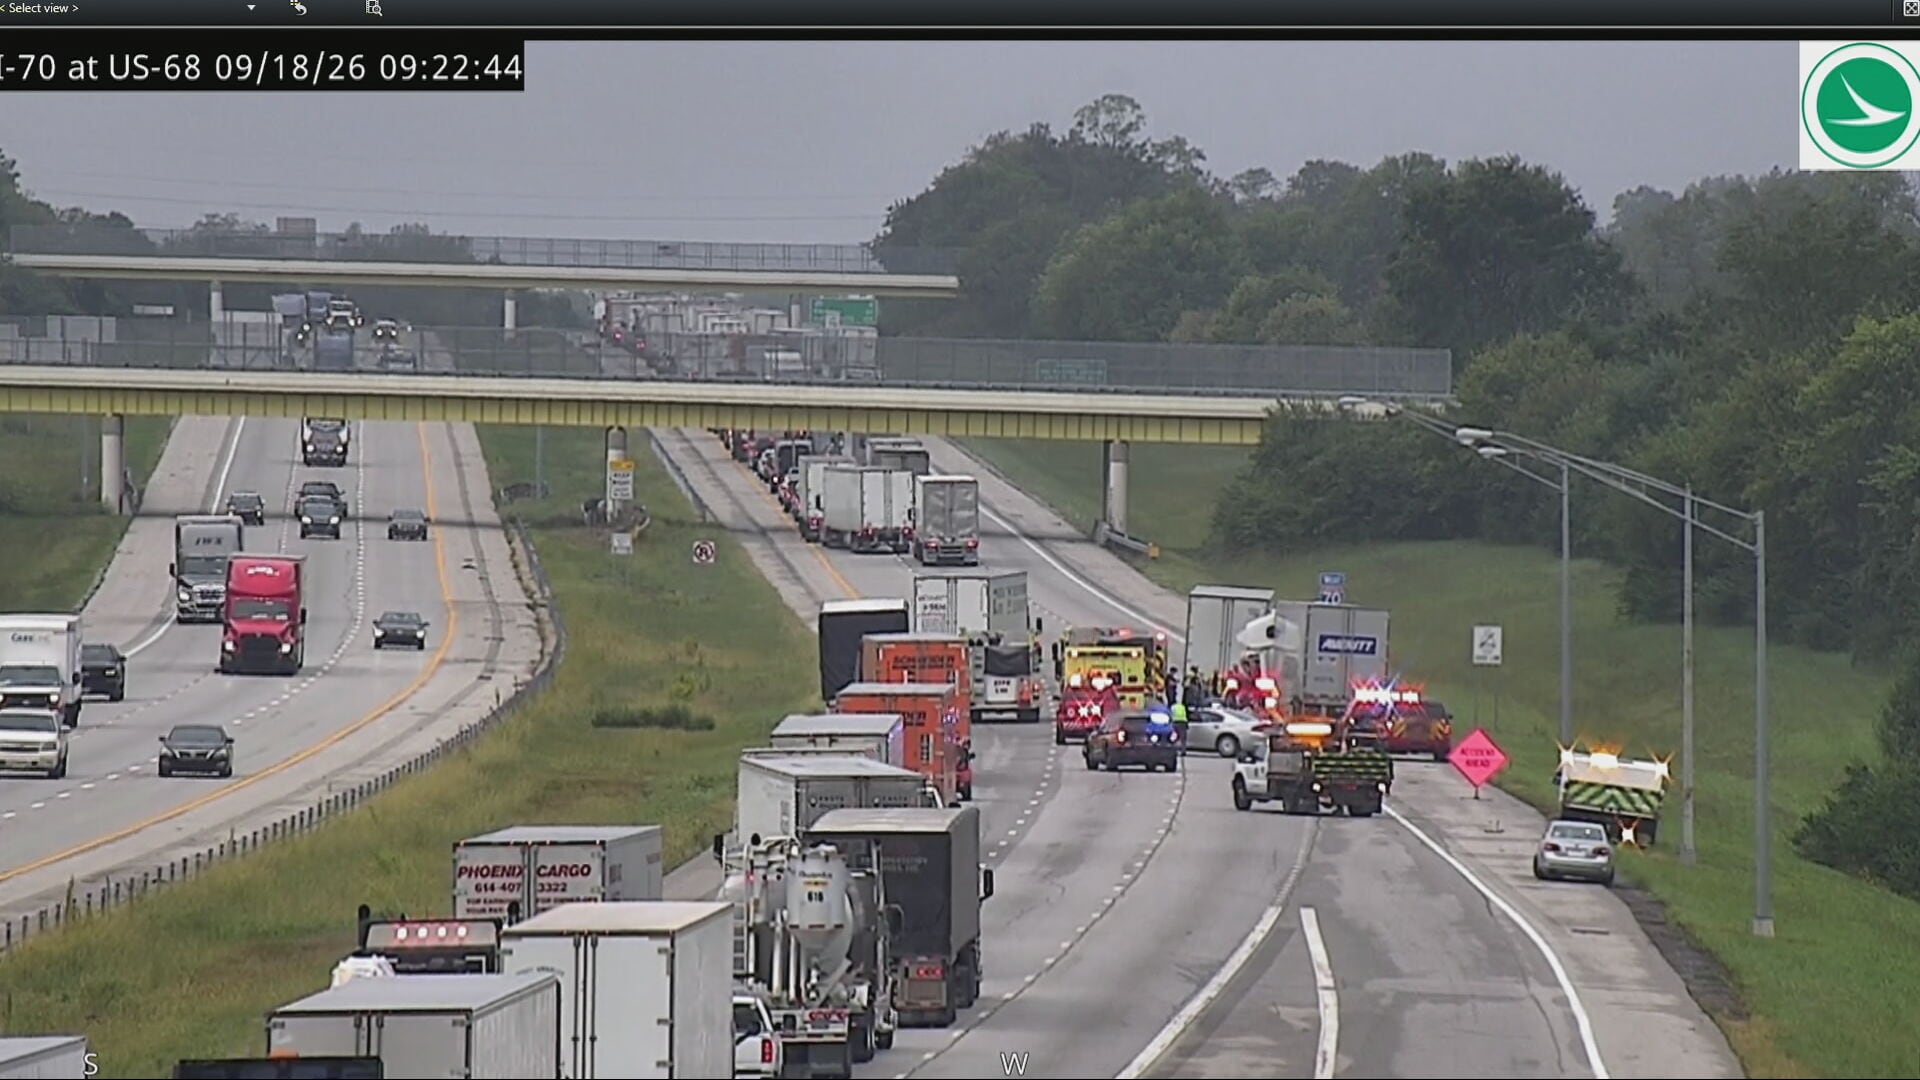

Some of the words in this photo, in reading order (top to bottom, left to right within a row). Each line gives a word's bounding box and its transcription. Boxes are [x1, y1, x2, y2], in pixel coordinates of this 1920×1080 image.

[1322, 592, 1342, 606] 70
[1465, 759, 1490, 768] AHEAD
[458, 864, 526, 879] PHOENIX
[536, 864, 592, 878] CARGO
[537, 882, 568, 893] 3322
